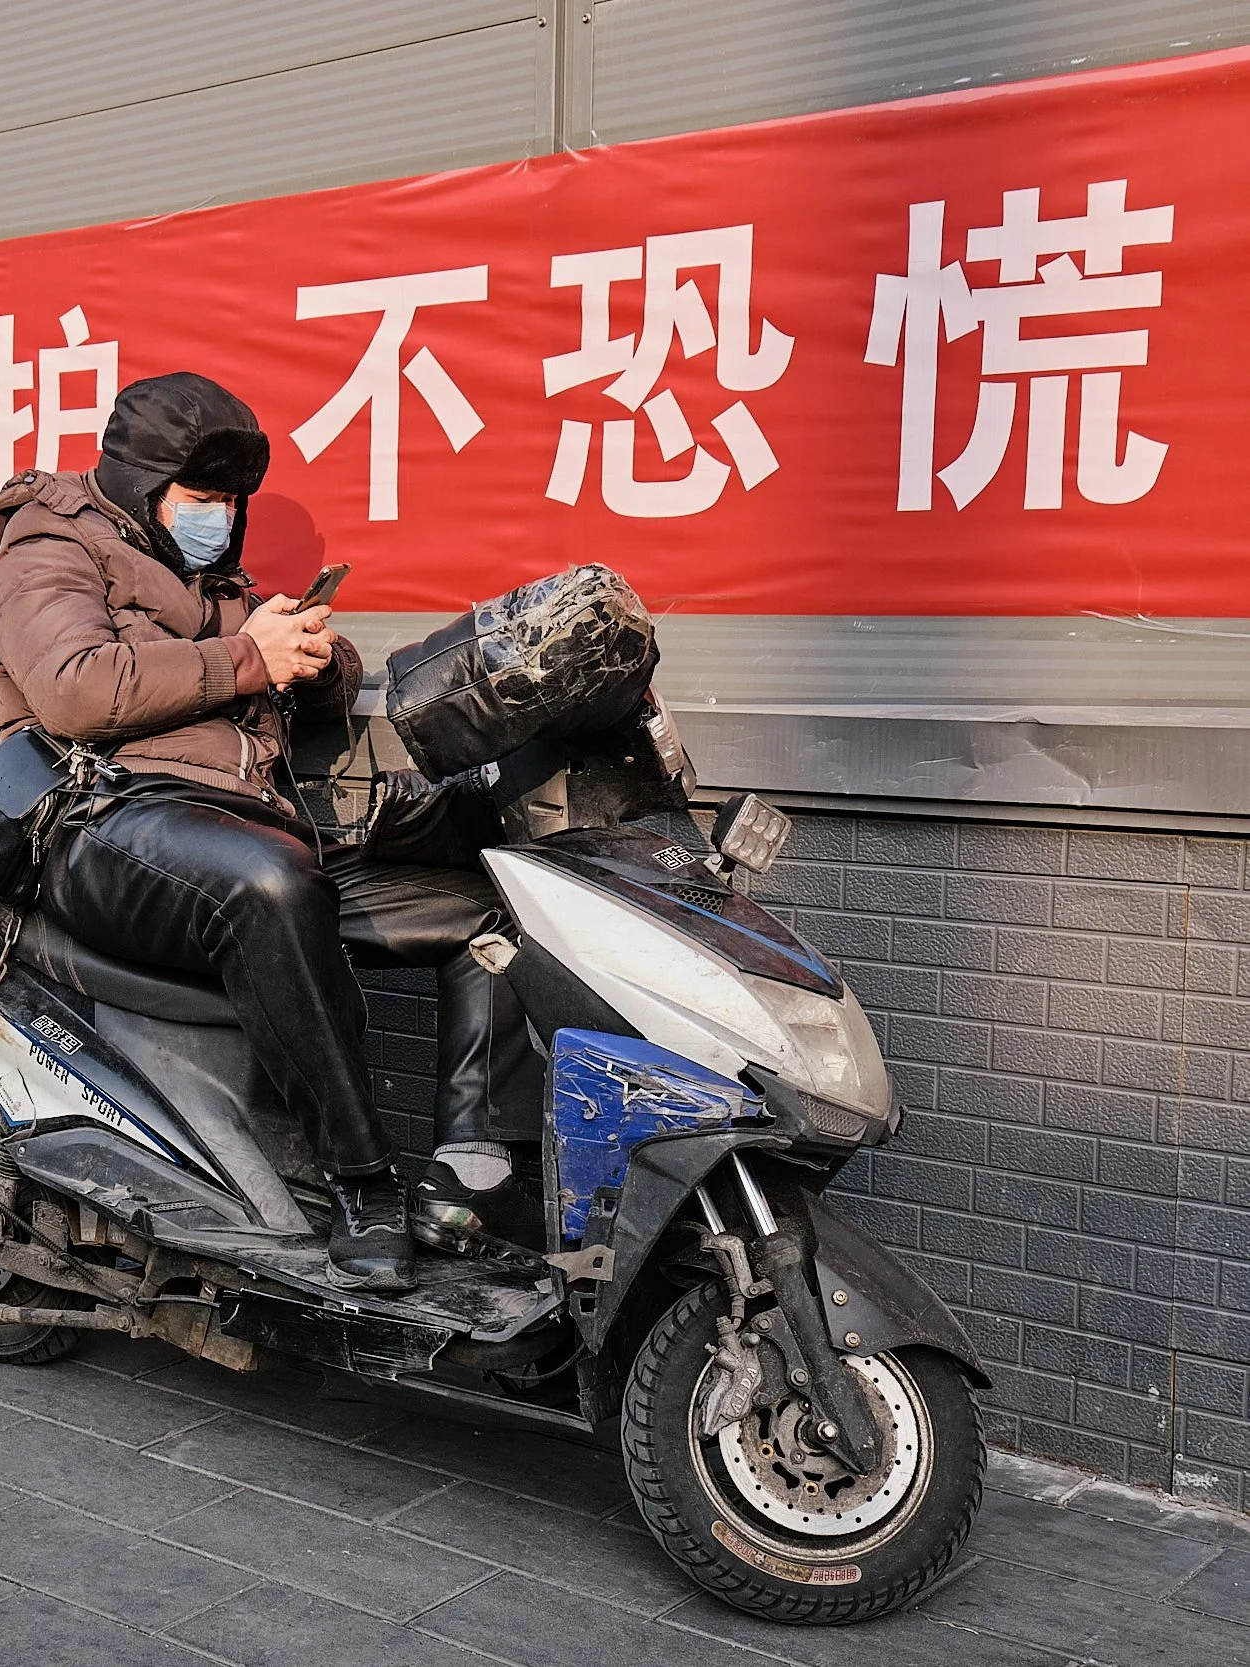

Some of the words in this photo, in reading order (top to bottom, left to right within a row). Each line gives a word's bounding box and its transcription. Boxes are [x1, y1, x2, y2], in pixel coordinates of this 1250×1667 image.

[289, 178, 1175, 521] 不恐慌
[29, 1044, 71, 1086] POWER
[81, 1084, 126, 1127] SPORT
